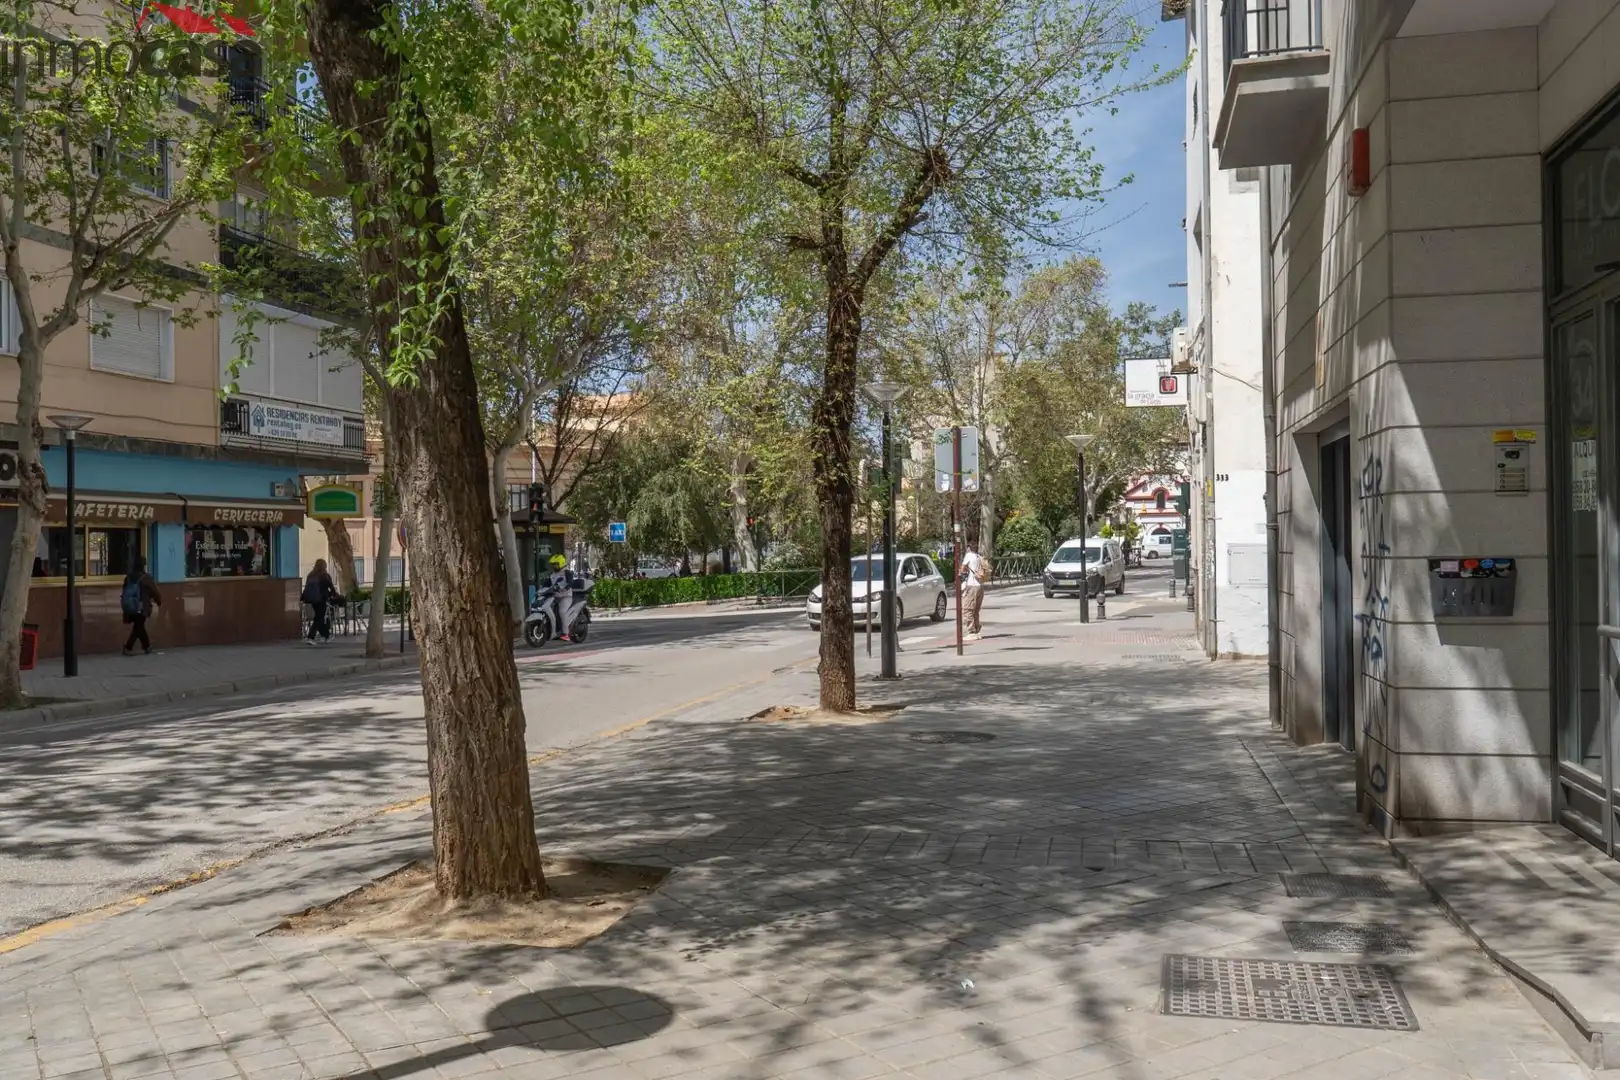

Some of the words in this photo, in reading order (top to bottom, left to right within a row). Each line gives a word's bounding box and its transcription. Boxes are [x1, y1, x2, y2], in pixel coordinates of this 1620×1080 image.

[267, 407, 309, 423] RESIDENCIAS
[310, 414, 342, 428] RENTAHOY
[1573, 441, 1596, 458] ALQU
[214, 508, 284, 523] CERVECERIA
